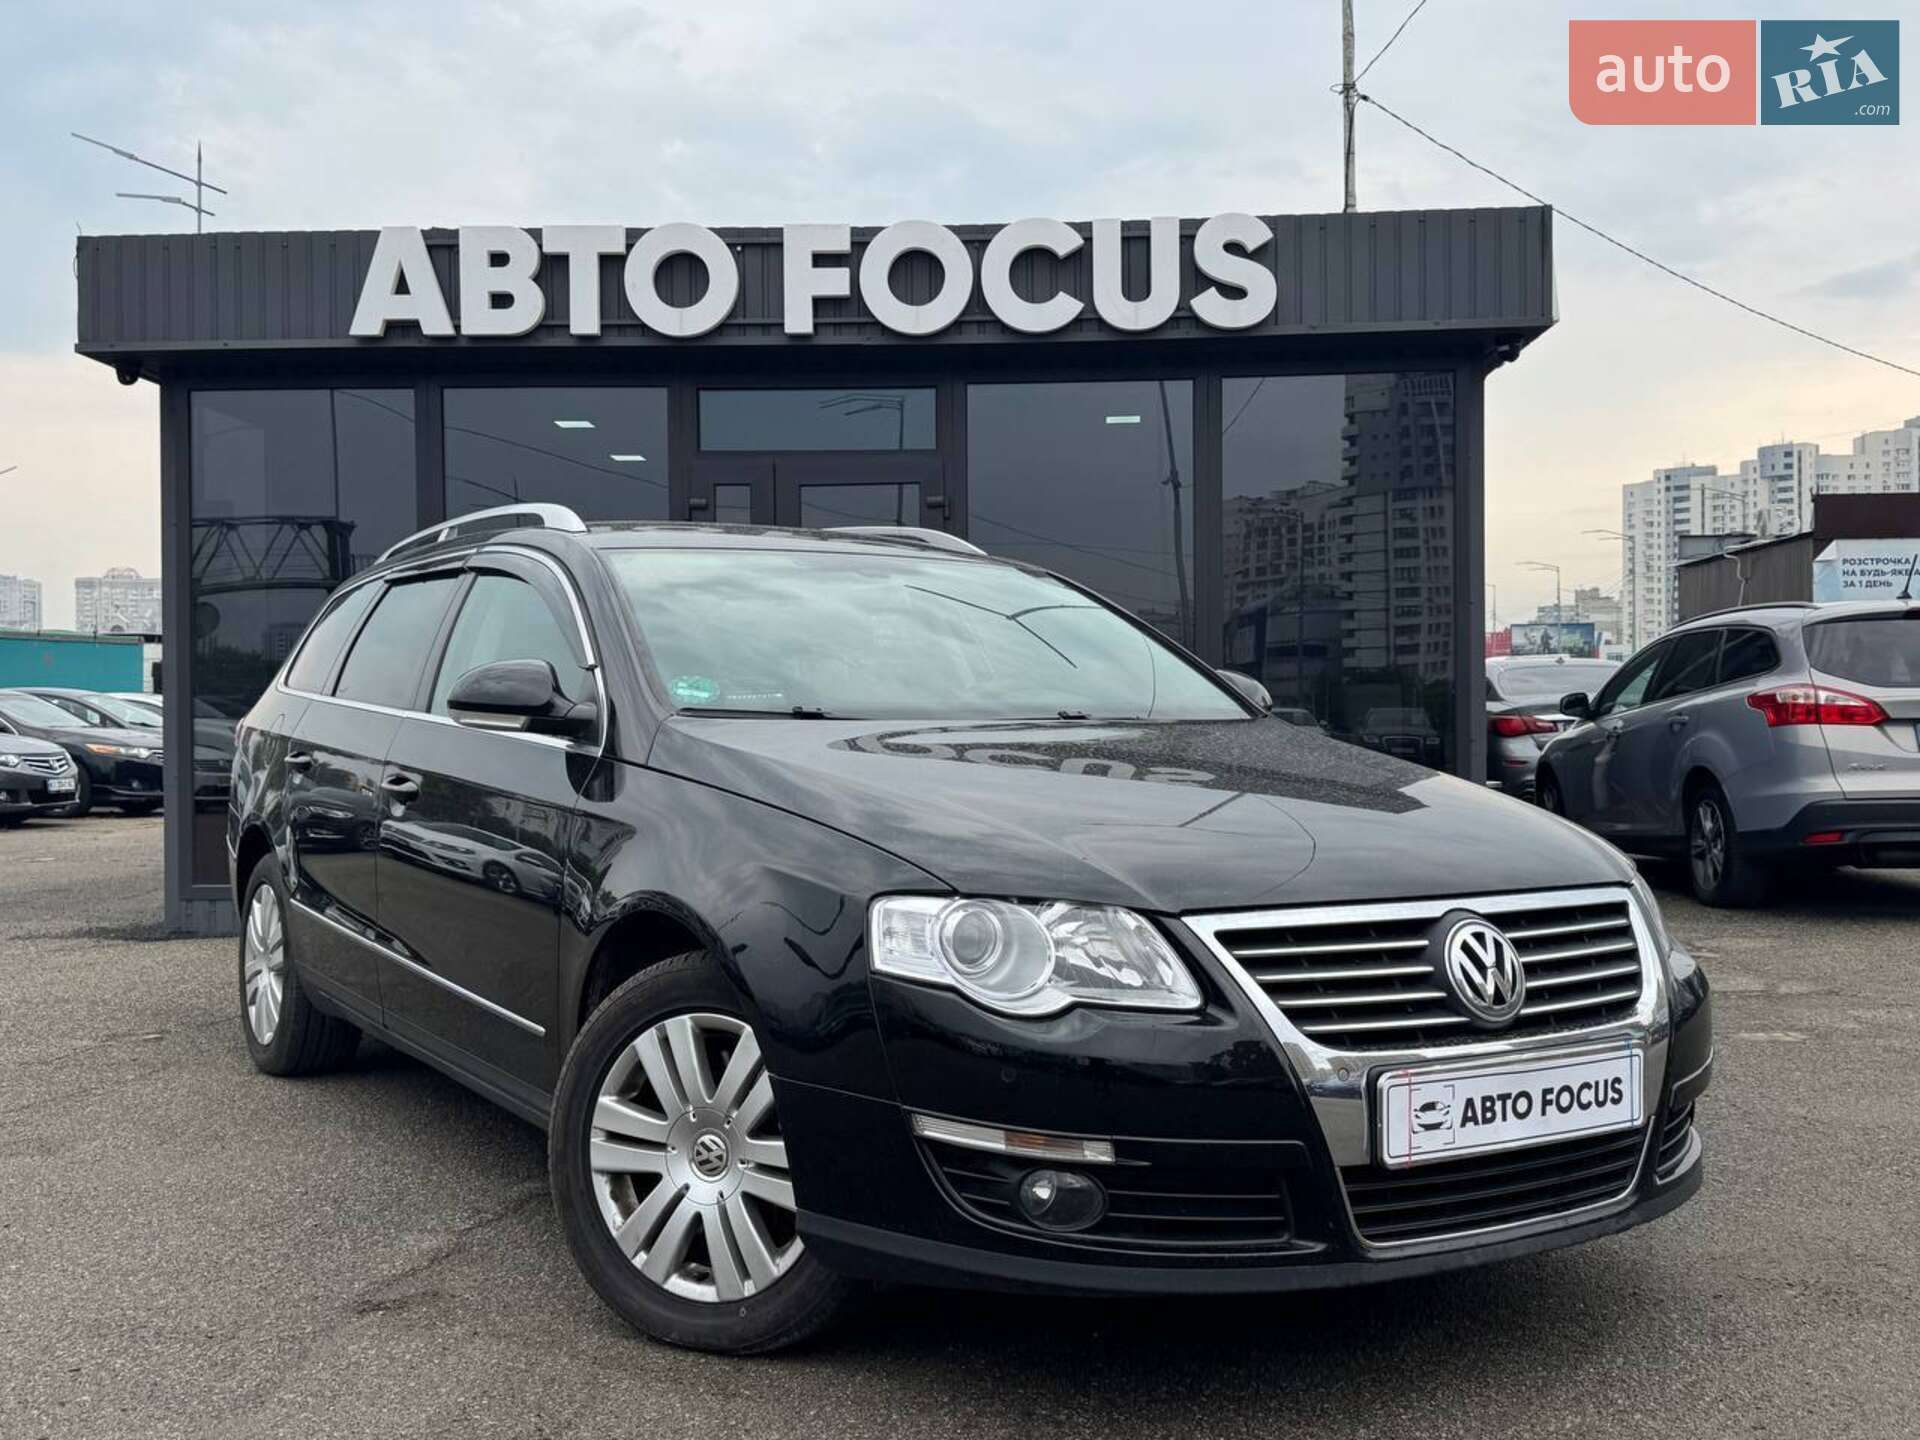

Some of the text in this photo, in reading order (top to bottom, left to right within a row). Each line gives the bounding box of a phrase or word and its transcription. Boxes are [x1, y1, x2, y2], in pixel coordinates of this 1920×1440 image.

[349, 212, 1277, 338] АВТО FOCUS
[1842, 557, 1911, 566] РОЗСТРОЧКА
[1842, 568, 1857, 577] НА
[1842, 580, 1856, 588] ЗА
[1865, 580, 1893, 588] ДЕНЬ
[1460, 1076, 1623, 1128] АВТО FOCUS
